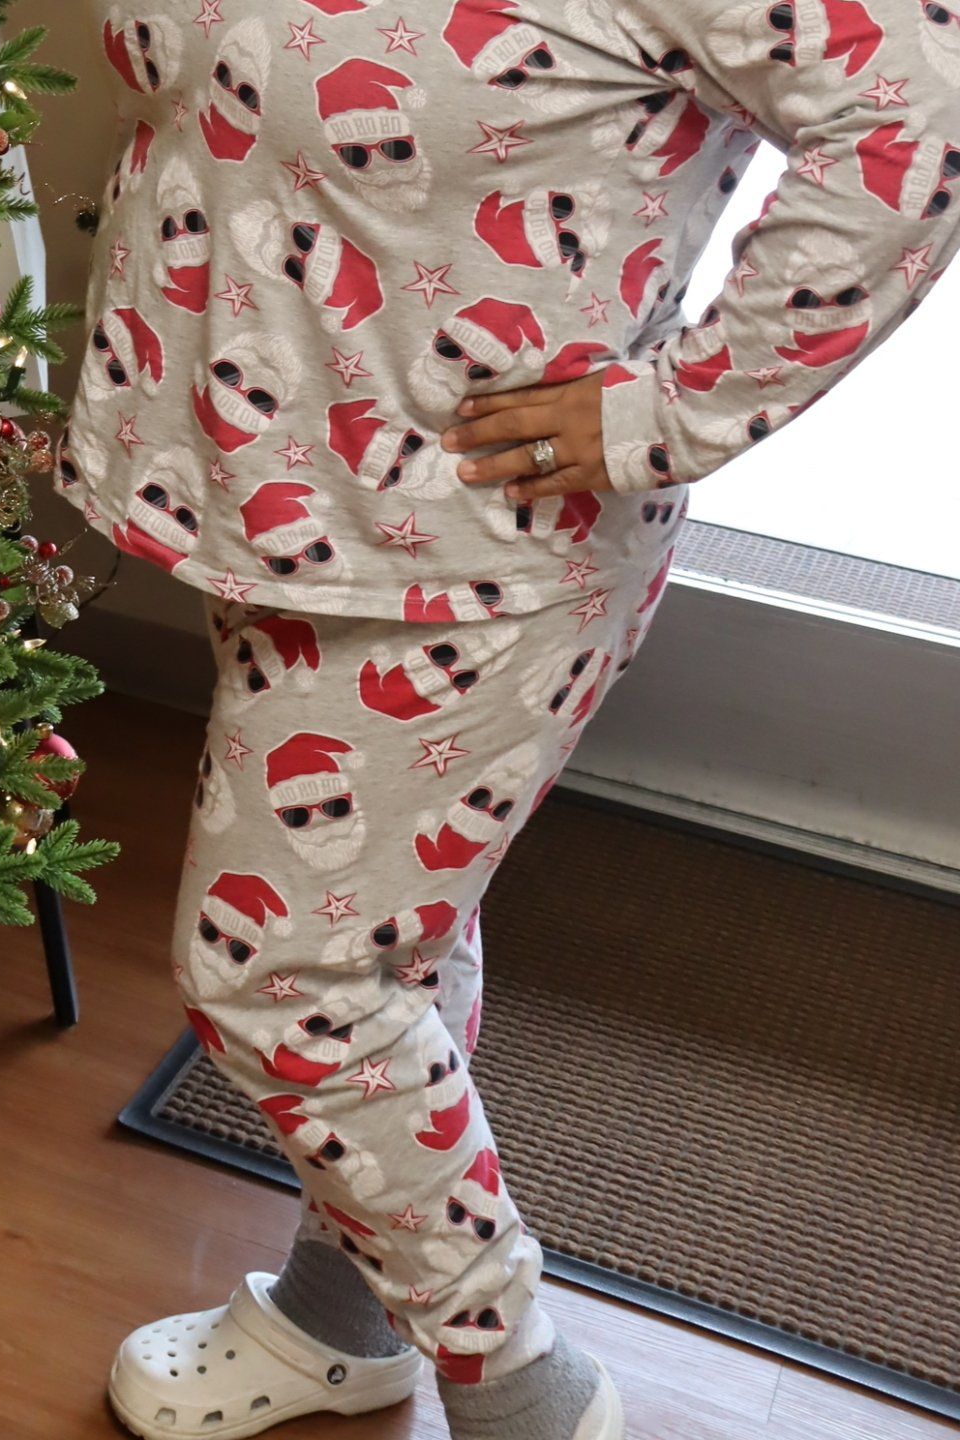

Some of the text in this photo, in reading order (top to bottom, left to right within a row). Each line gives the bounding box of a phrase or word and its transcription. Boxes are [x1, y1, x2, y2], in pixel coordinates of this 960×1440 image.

[491, 39, 517, 62] HO
[510, 27, 535, 51] HO
[329, 116, 401, 139] HO HO HO
[908, 166, 931, 187] HO
[529, 218, 550, 240] HO
[311, 255, 332, 278] HO
[450, 320, 475, 345] HO
[470, 334, 495, 359] HO
[216, 393, 240, 417] HO
